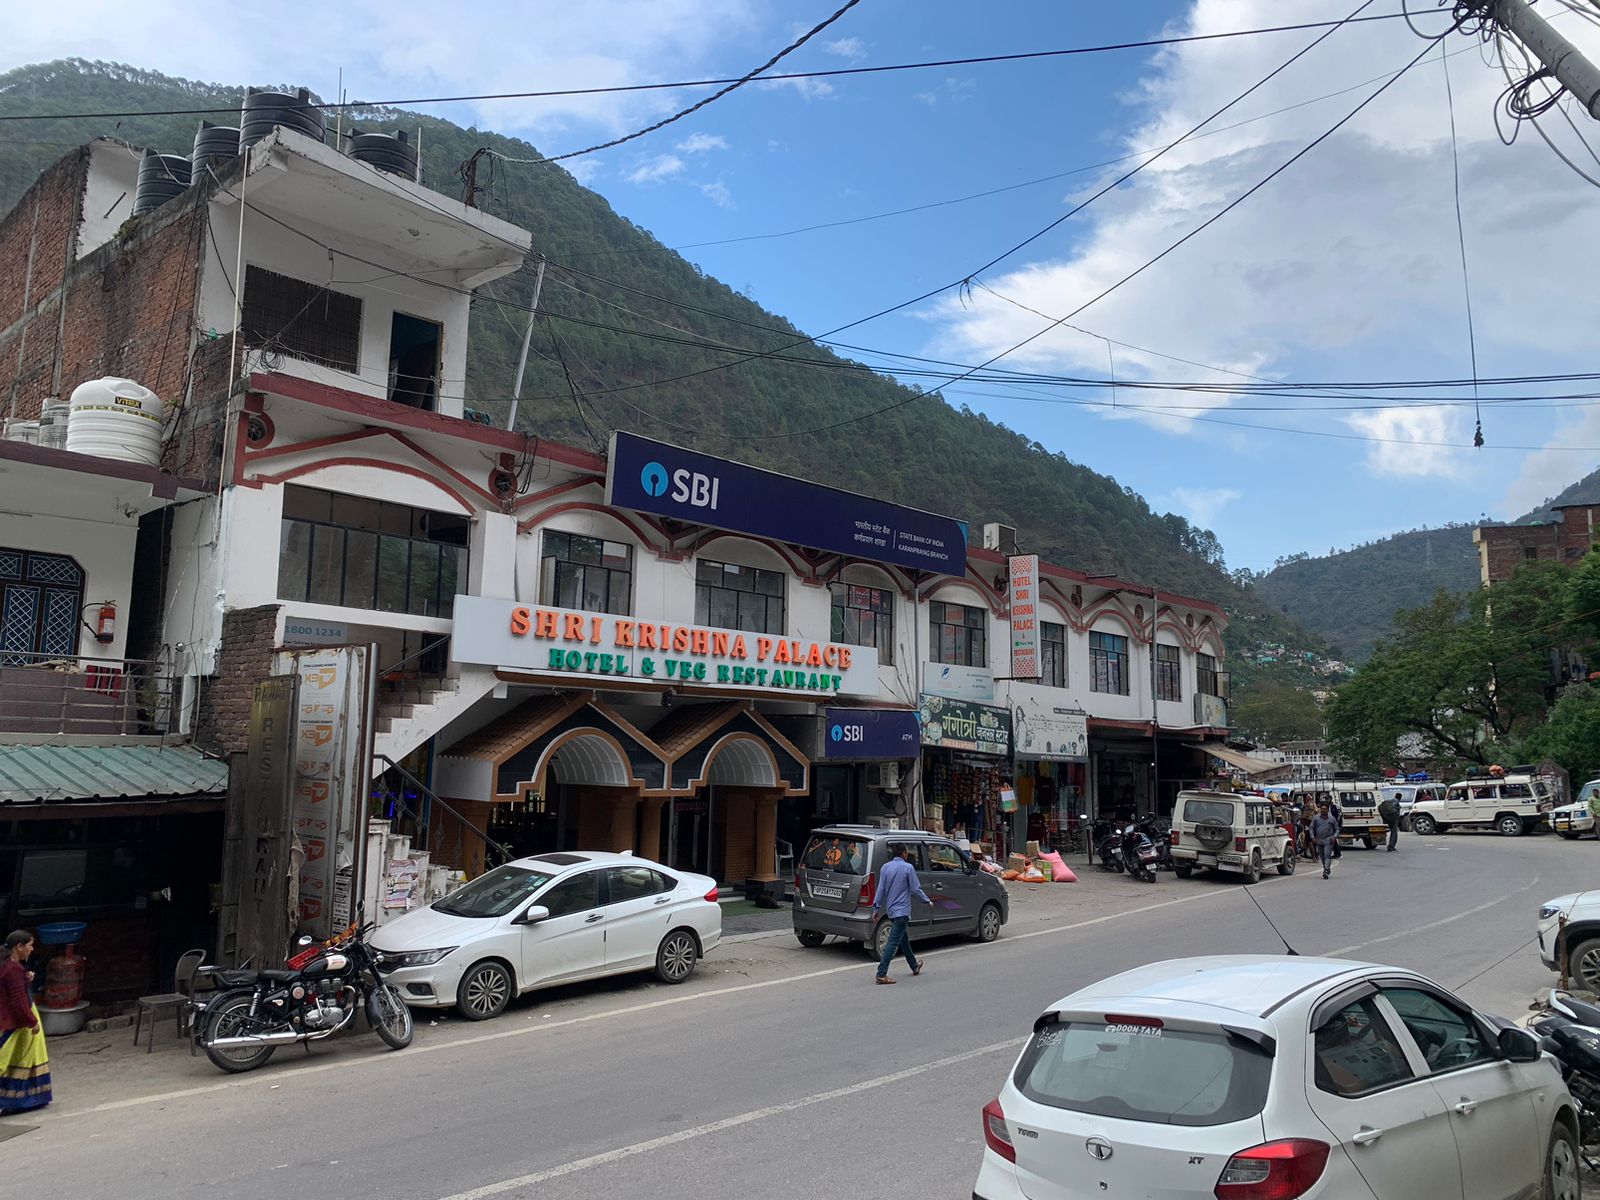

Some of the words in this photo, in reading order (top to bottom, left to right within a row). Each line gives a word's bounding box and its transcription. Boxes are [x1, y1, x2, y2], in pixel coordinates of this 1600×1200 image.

[672, 468, 719, 510] SBI
[900, 532, 912, 541] STATE
[913, 535, 925, 543] BANK
[932, 539, 944, 547] INDIA
[899, 545, 930, 556] KARANPRAYAG
[931, 551, 948, 560] BRANCH
[1012, 576, 1031, 587] HOTEL
[1015, 589, 1029, 601] SHRI
[285, 625, 312, 636] 1800
[315, 628, 341, 638] 1234
[1014, 620, 1033, 631] PALACE
[510, 607, 603, 643] SHRI
[615, 620, 748, 659] KRISHNA
[757, 637, 853, 669] PALACE
[549, 647, 630, 674] HOTEL
[642, 657, 656, 675] &
[665, 659, 706, 681] VEG
[718, 664, 842, 691] RESTAURANT
[942, 710, 977, 739] गंगोत्री
[843, 725, 864, 742] SBI
[901, 734, 913, 742] ATM
[1117, 1024, 1139, 1033] DOON
[1139, 1026, 1162, 1036] TATA
[1188, 1156, 1205, 1165] XT
